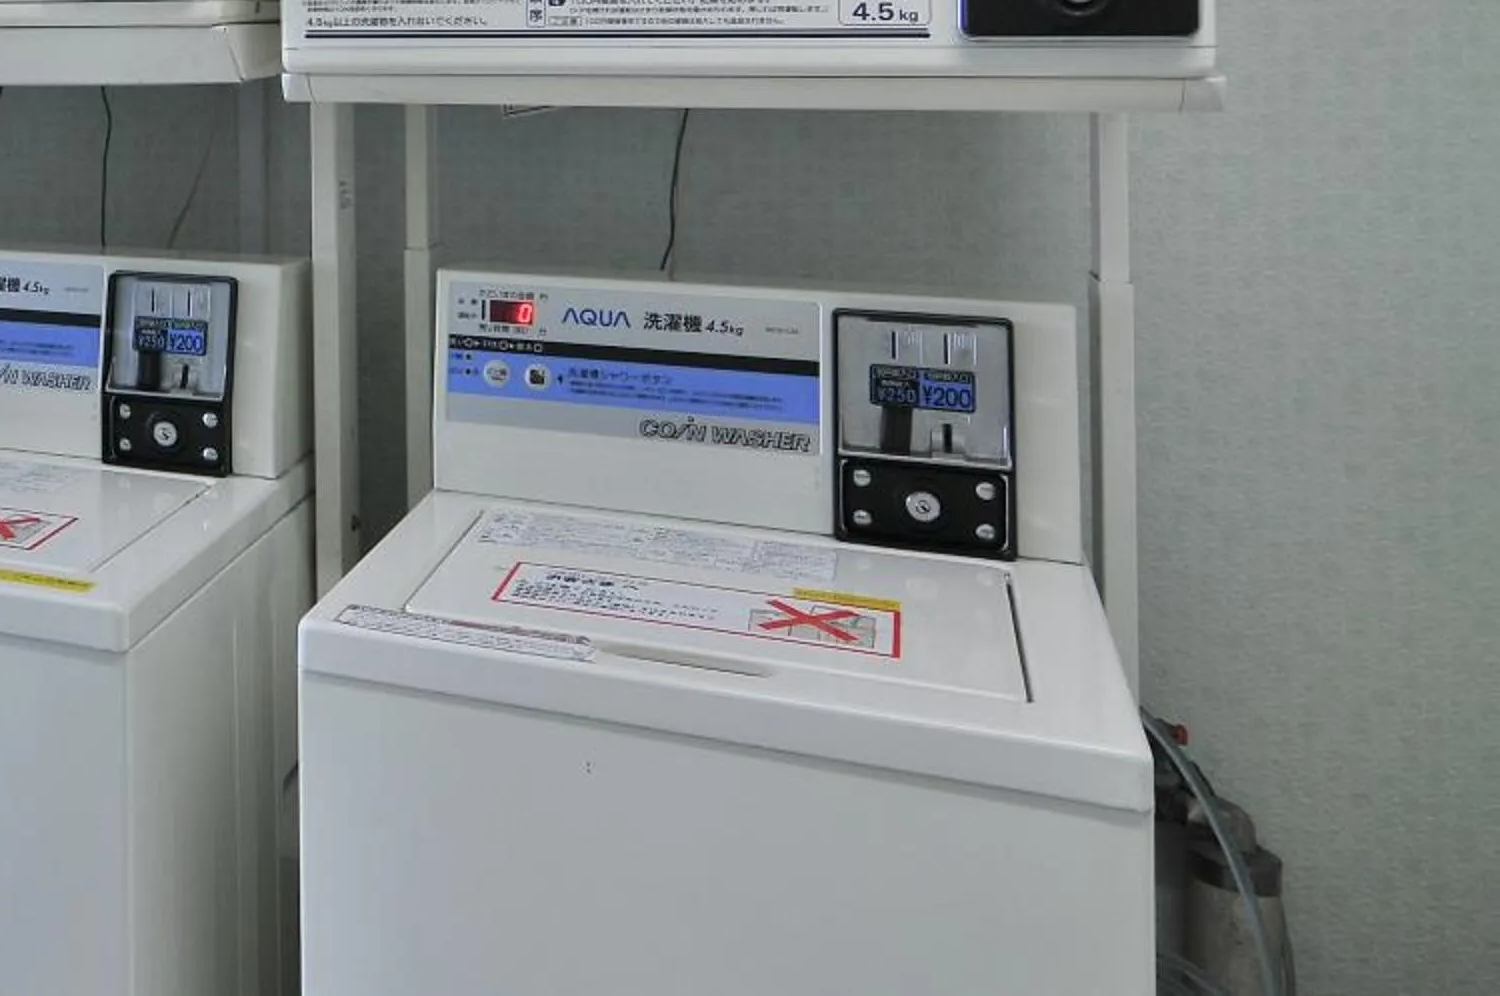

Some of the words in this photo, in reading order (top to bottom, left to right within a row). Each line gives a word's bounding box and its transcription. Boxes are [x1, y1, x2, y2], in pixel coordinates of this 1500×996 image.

[518, 303, 533, 323] 0
[562, 307, 631, 329] AQUA
[643, 311, 702, 333] 洗濯機
[705, 319, 745, 337] 4.5kg
[639, 416, 707, 442] COIN
[710, 424, 811, 452] WASHER
